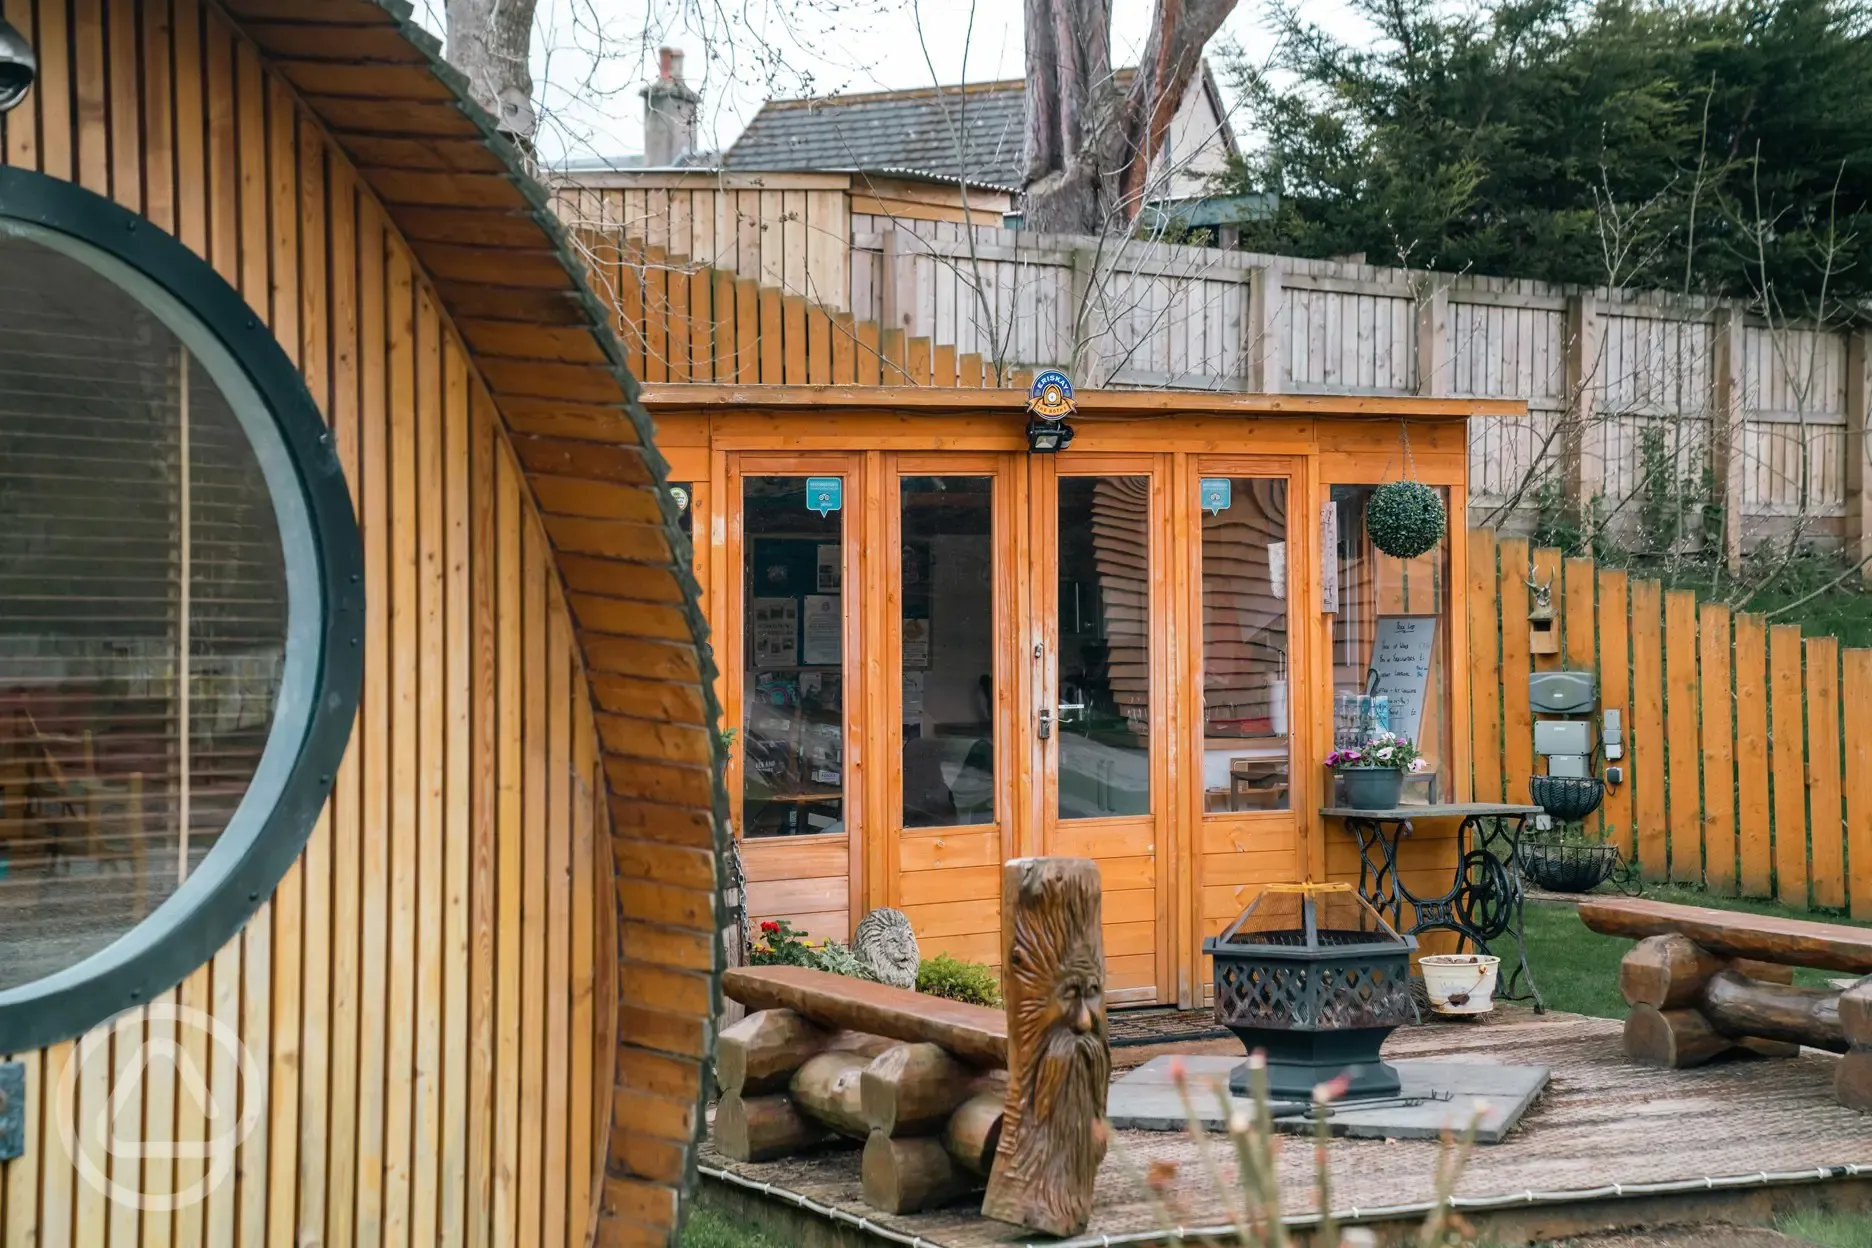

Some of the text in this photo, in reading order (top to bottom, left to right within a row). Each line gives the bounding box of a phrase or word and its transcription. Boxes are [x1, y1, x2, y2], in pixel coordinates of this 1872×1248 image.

[1037, 375, 1069, 389] ERISKAY
[1037, 404, 1067, 414] THE BOTHY
